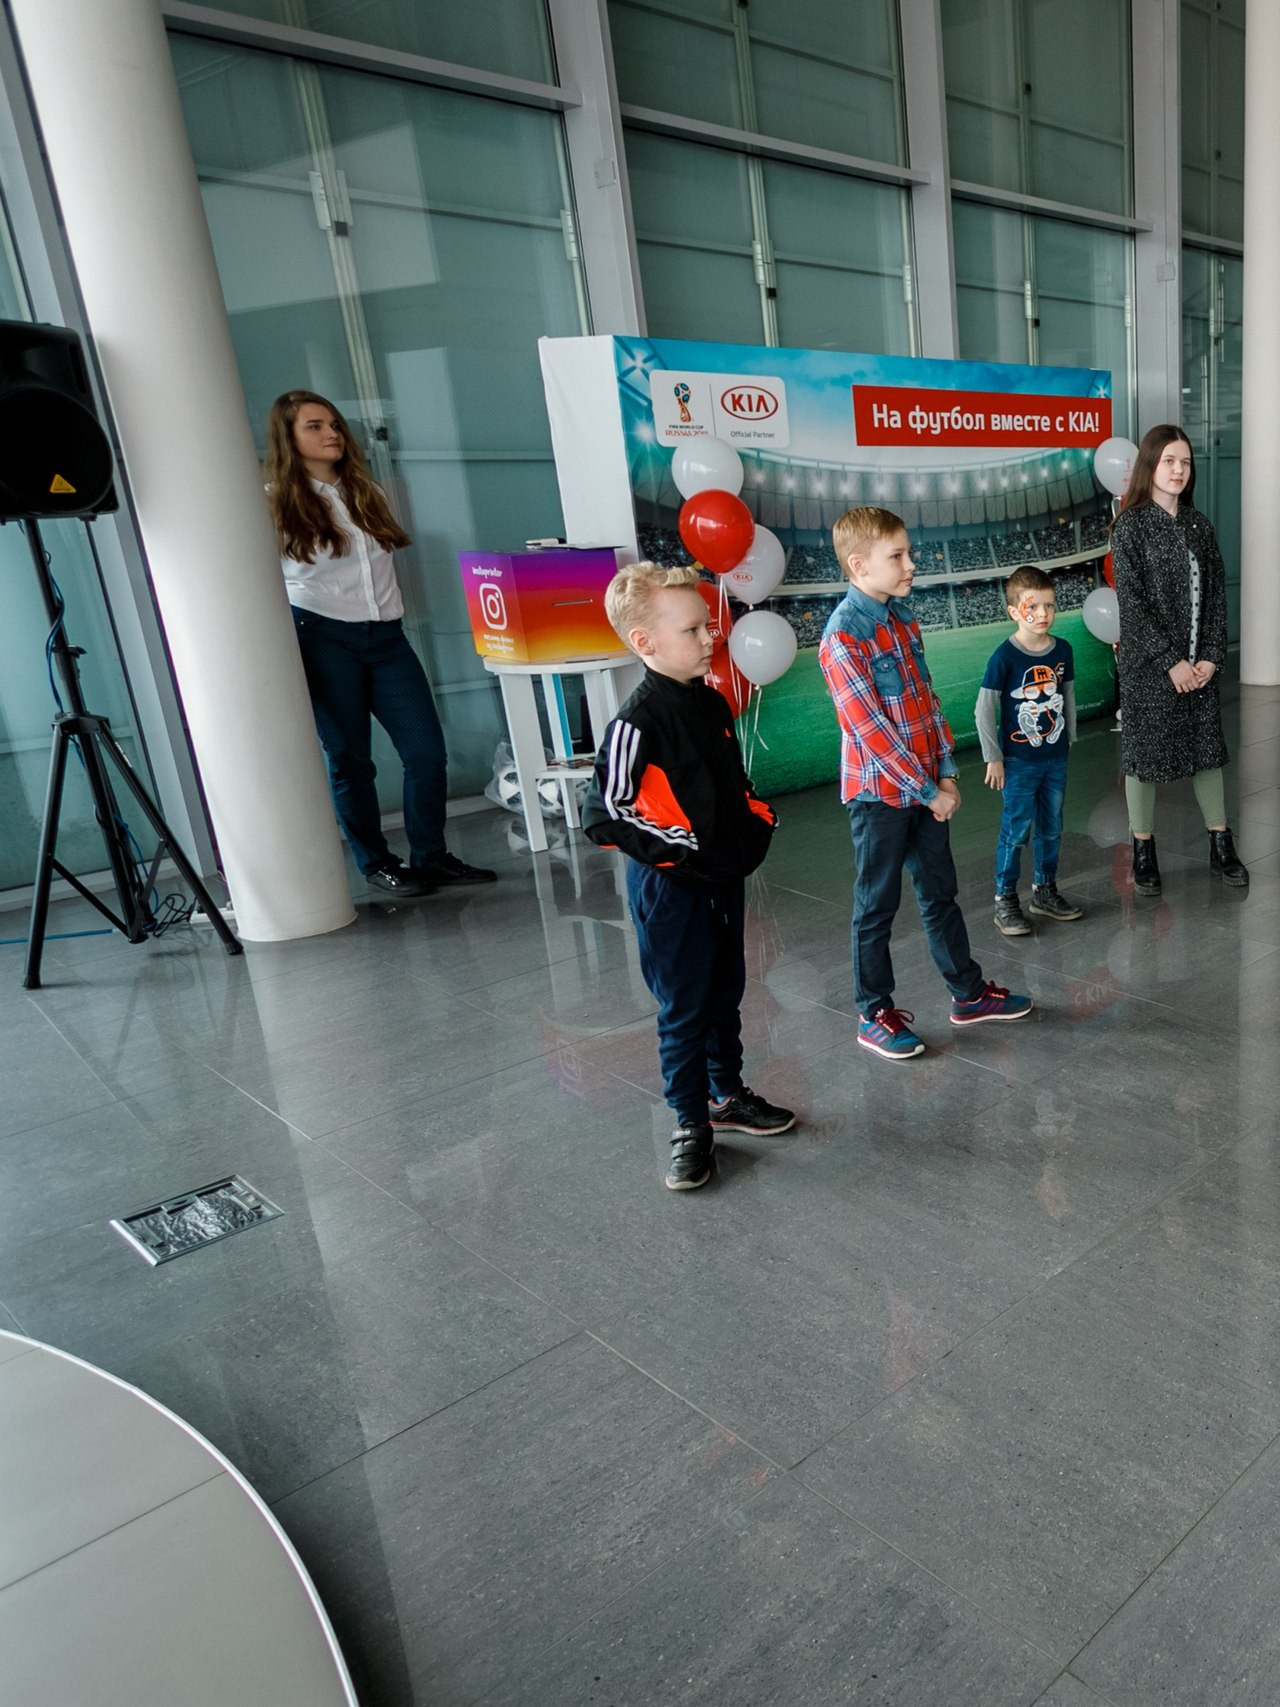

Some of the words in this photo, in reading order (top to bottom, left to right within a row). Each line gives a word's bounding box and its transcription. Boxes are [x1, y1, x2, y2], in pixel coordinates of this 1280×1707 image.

[730, 393, 770, 413] KIA
[872, 403, 902, 429] На
[908, 404, 985, 434] футбол
[990, 412, 1051, 432] вместе
[1055, 414, 1064, 432] с
[1068, 411, 1100, 433] KIA!
[665, 429, 693, 437] RUSSIA
[730, 430, 752, 438] Official
[753, 431, 775, 439] Partner
